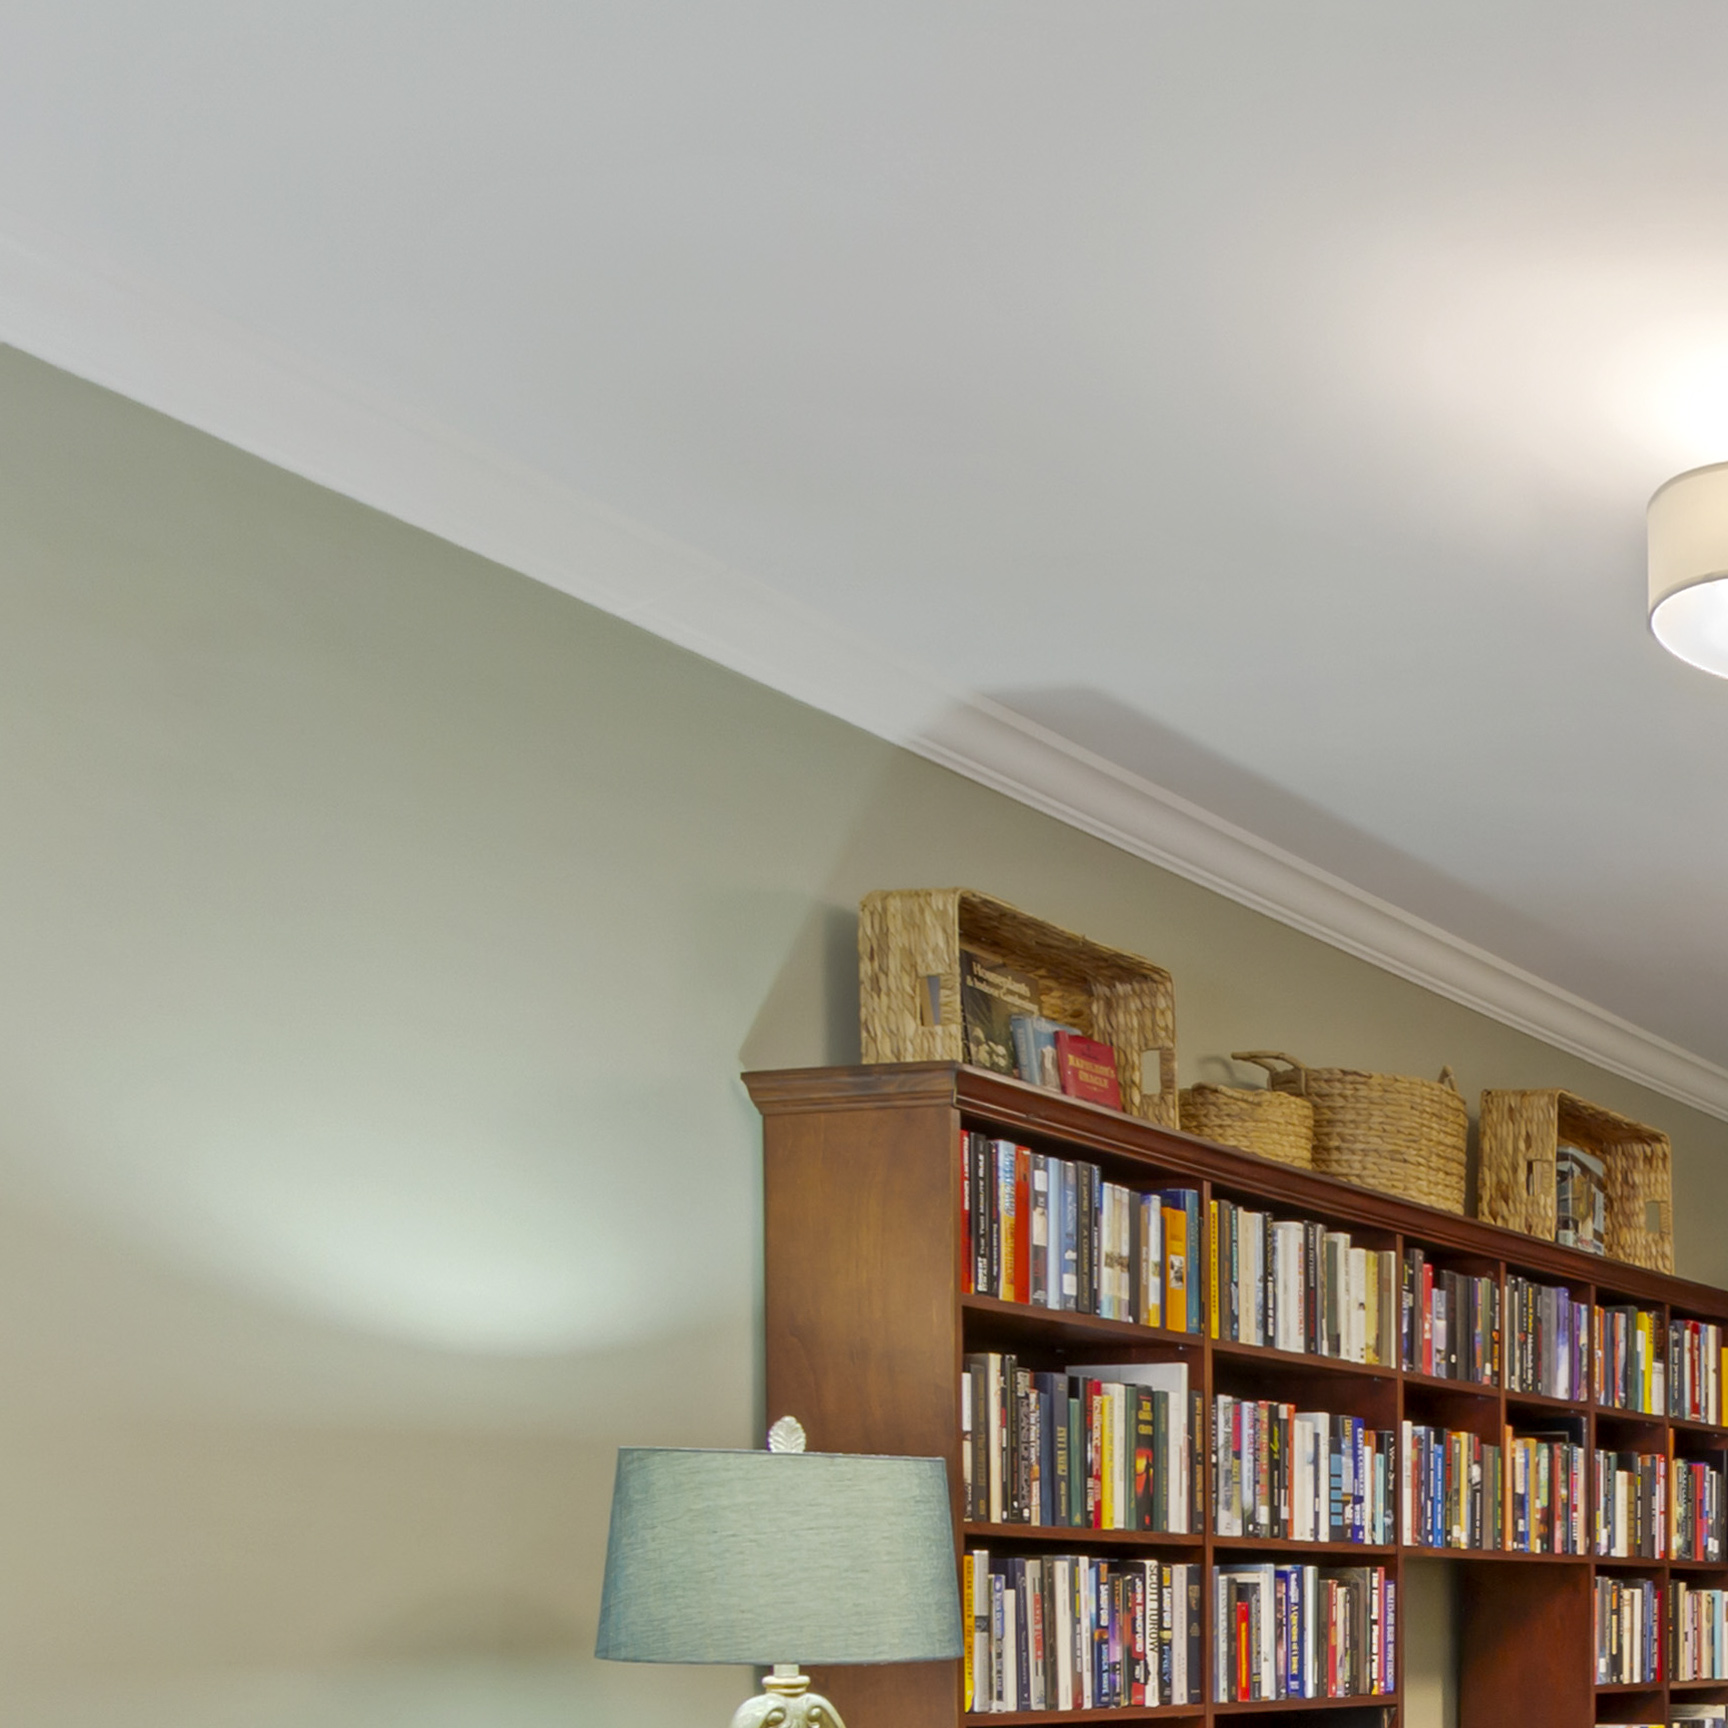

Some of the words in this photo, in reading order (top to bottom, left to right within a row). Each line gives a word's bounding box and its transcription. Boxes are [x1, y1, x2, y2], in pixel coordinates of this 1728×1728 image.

[1092, 1395, 1102, 1447] Resilience
[1135, 1578, 1143, 1603] JOHN
[1149, 1564, 1159, 1602] SCOTT
[1099, 1584, 1109, 1626] SANFORD
[1162, 1587, 1172, 1628] SANFORD
[1135, 1605, 1143, 1653] SANFORD
[1149, 1607, 1159, 1653] TUROW
[1162, 1645, 1171, 1683] PREY
